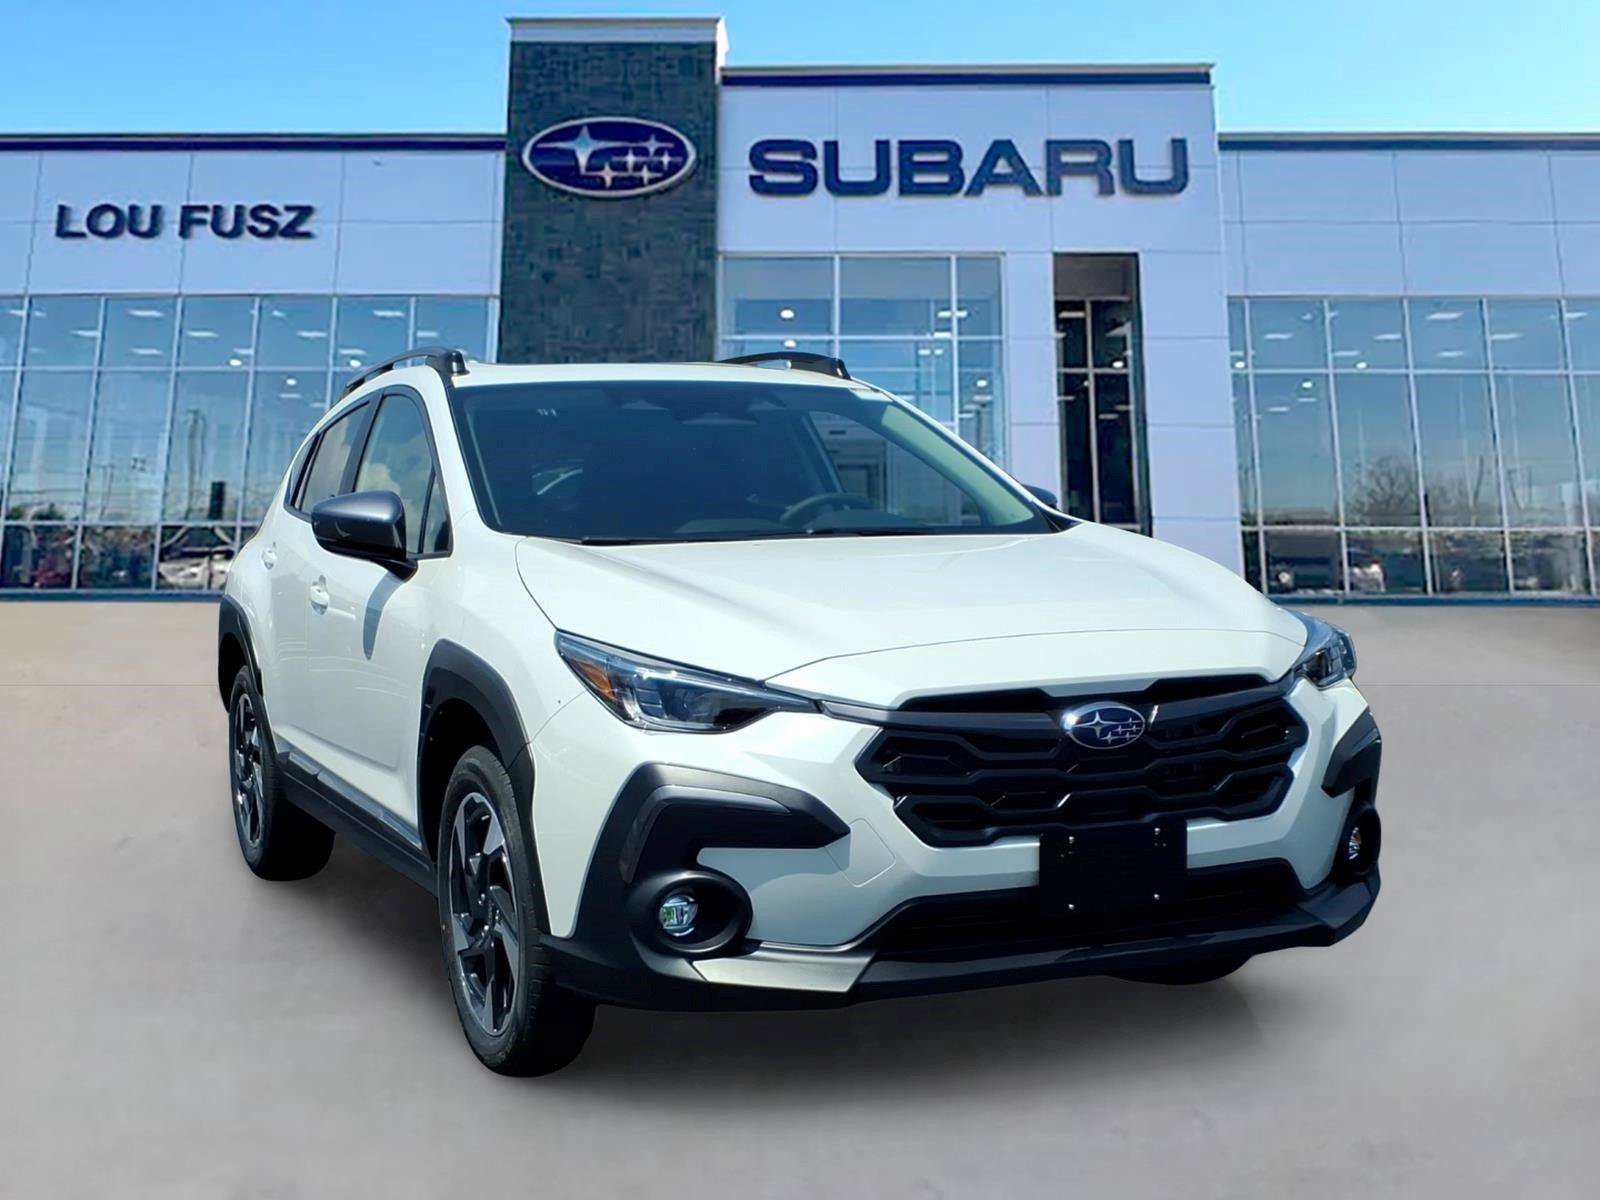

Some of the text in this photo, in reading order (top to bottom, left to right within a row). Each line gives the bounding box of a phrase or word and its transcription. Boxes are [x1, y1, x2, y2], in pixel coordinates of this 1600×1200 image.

[748, 138, 1189, 197] SUBARU
[56, 204, 315, 239] LOU FUSZ
